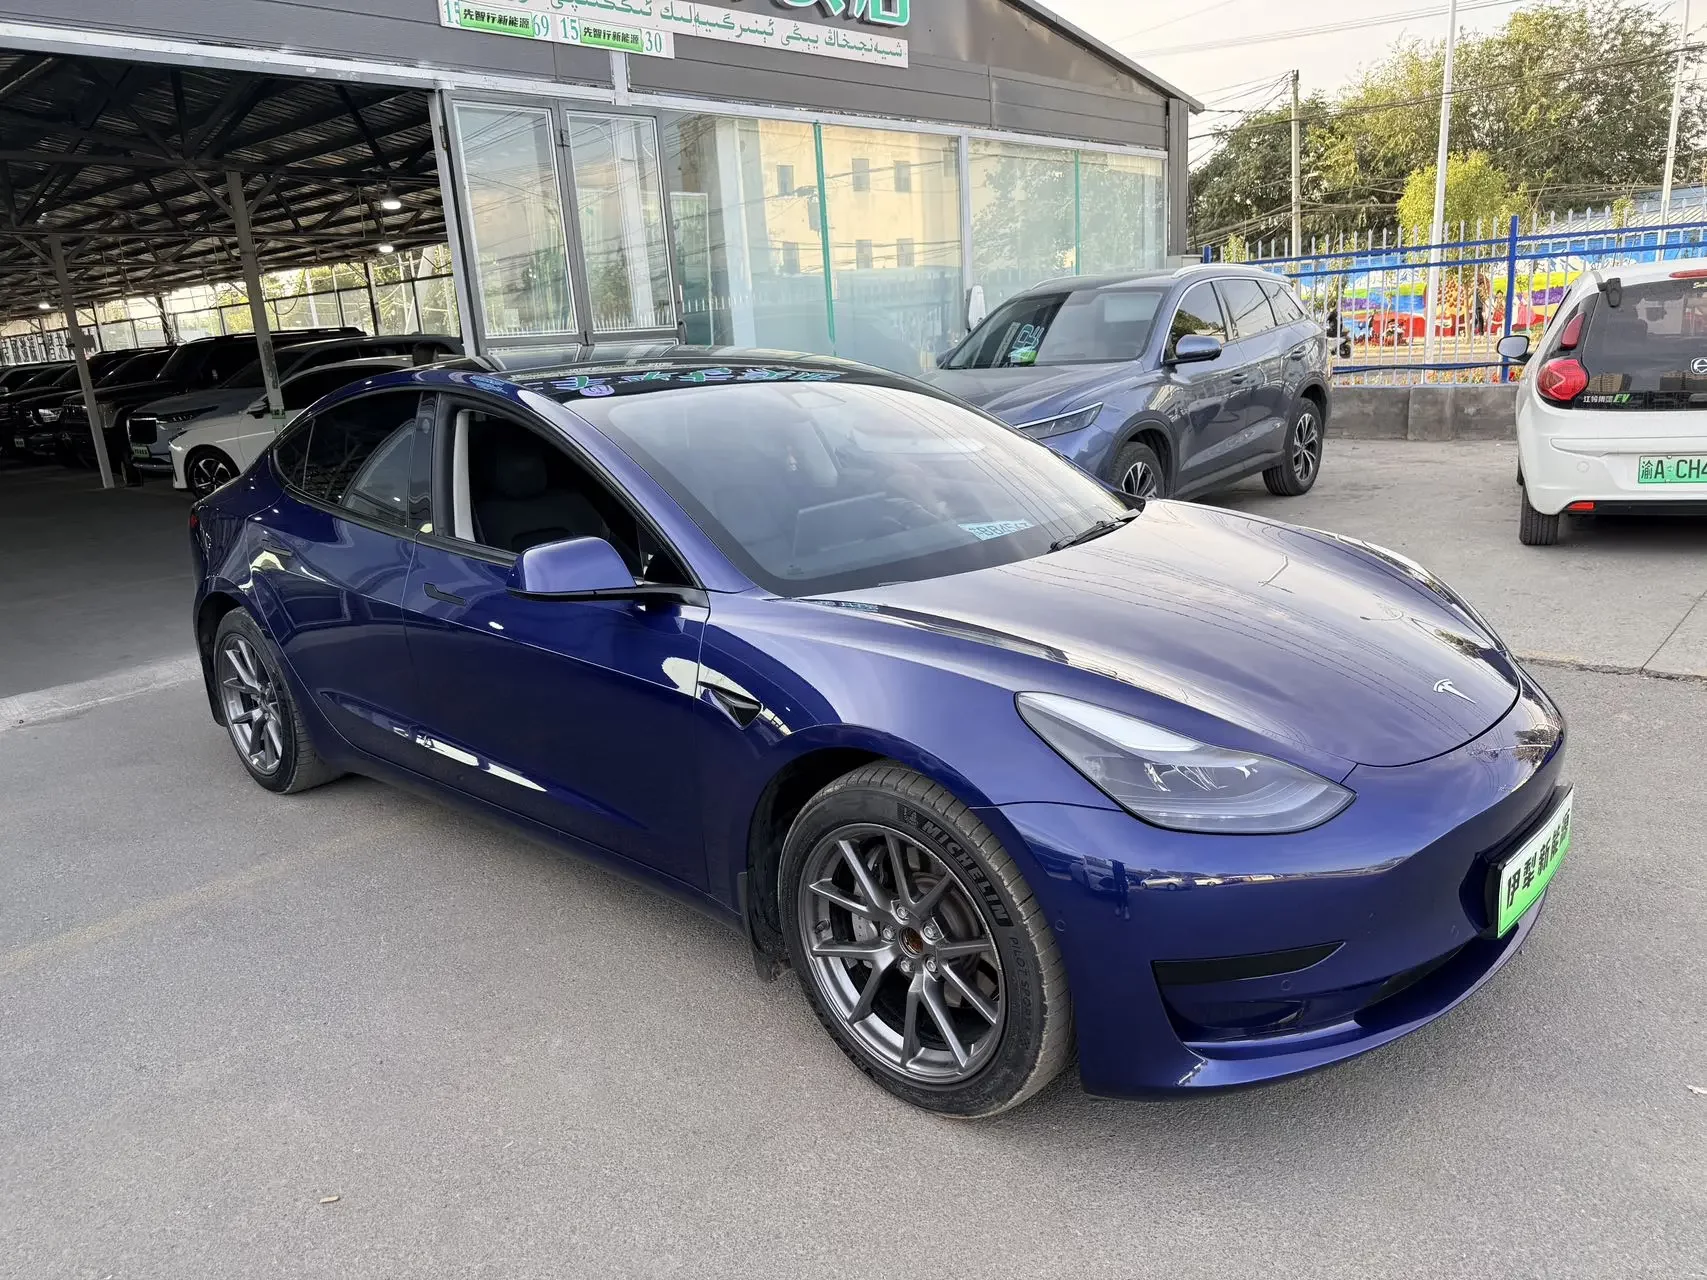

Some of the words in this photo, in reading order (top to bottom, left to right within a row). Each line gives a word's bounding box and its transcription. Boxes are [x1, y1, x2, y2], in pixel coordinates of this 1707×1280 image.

[463, 8, 530, 29] 先智行新能源
[560, 17, 579, 40] 15
[645, 31, 662, 53] 30
[583, 27, 639, 45] 先智行新能源
[922, 820, 1009, 919] MICHELIN
[1008, 936, 1027, 976] PILOT
